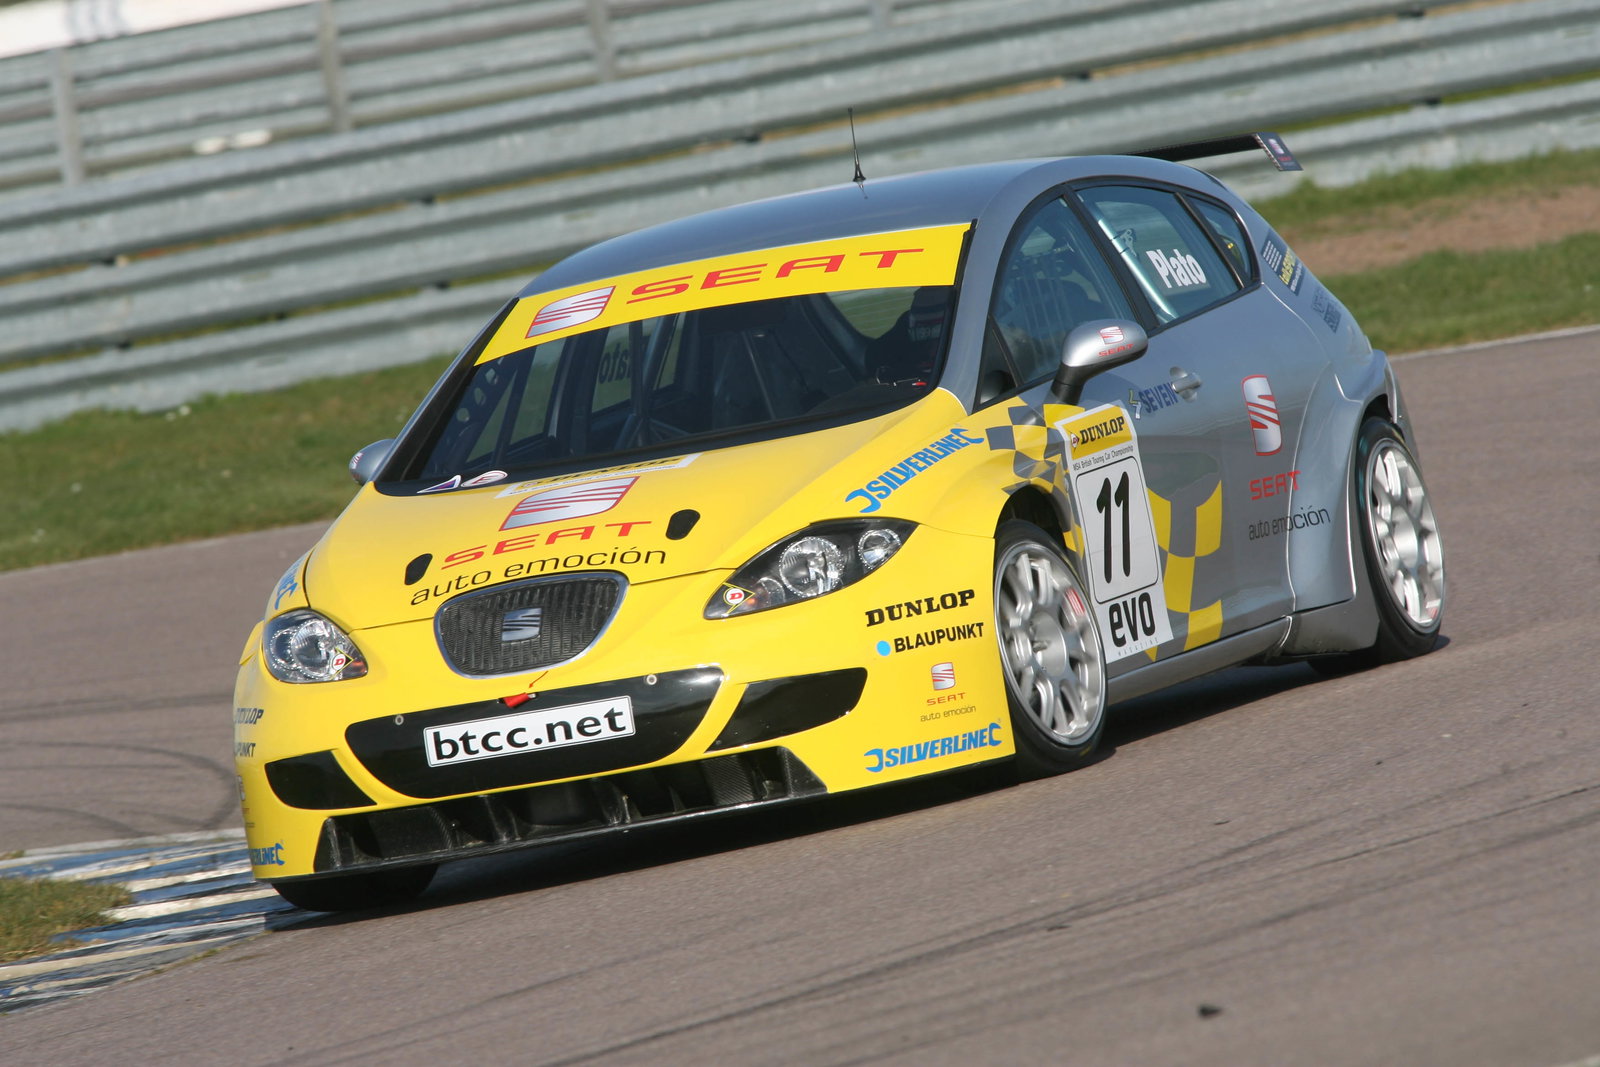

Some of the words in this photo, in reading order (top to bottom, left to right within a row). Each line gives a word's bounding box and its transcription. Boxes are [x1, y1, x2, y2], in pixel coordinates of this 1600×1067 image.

[626, 248, 925, 304] SEAT
[1146, 248, 1207, 289] Plato
[1098, 343, 1134, 357] SEAT
[1079, 416, 1125, 445] DUNLOP
[1249, 470, 1302, 500] SEAT
[1096, 471, 1131, 584] 11
[1249, 521, 1270, 541] auto
[1272, 505, 1331, 536] emoción
[441, 520, 652, 570] SEAT
[410, 570, 491, 606] auto
[503, 547, 667, 578] emoción
[865, 589, 976, 627] DUNLOP
[1109, 592, 1156, 648] evo
[893, 622, 984, 653] BLAUPUNKT
[920, 712, 941, 722] auto
[926, 692, 966, 706] SEAT
[433, 707, 626, 761] btcc.net
